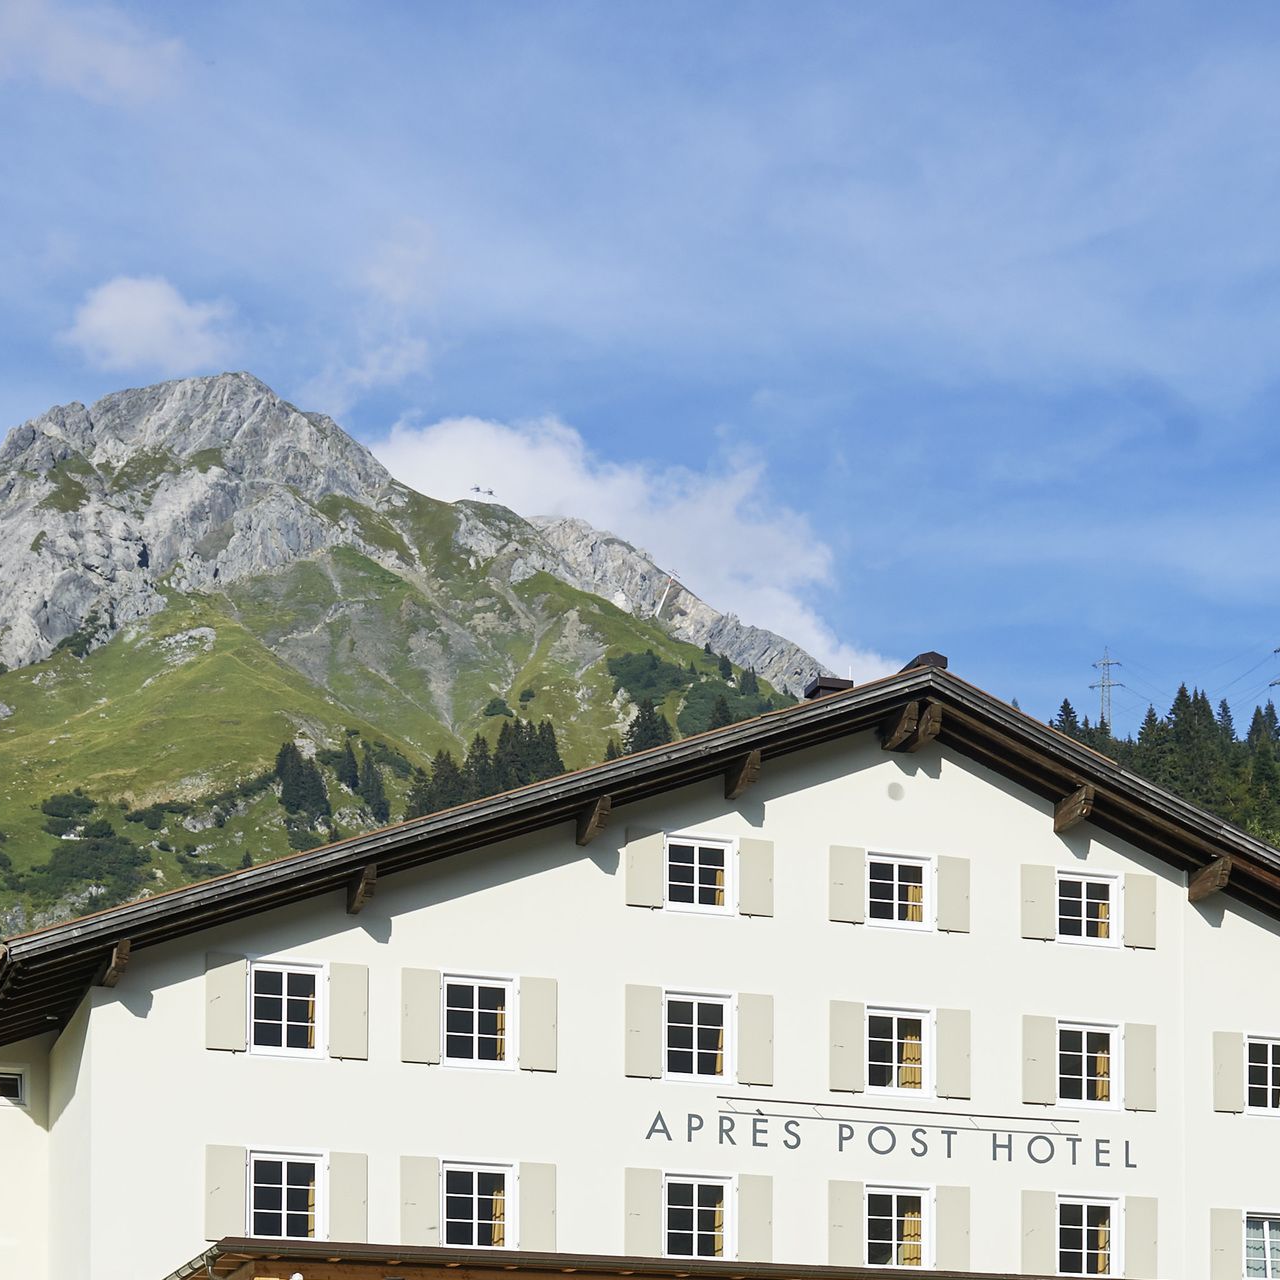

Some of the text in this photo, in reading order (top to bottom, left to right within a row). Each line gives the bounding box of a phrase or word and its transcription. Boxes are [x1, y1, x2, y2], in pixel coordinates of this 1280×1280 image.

[645, 1108, 1137, 1169] APRÈS POST HOTEL
